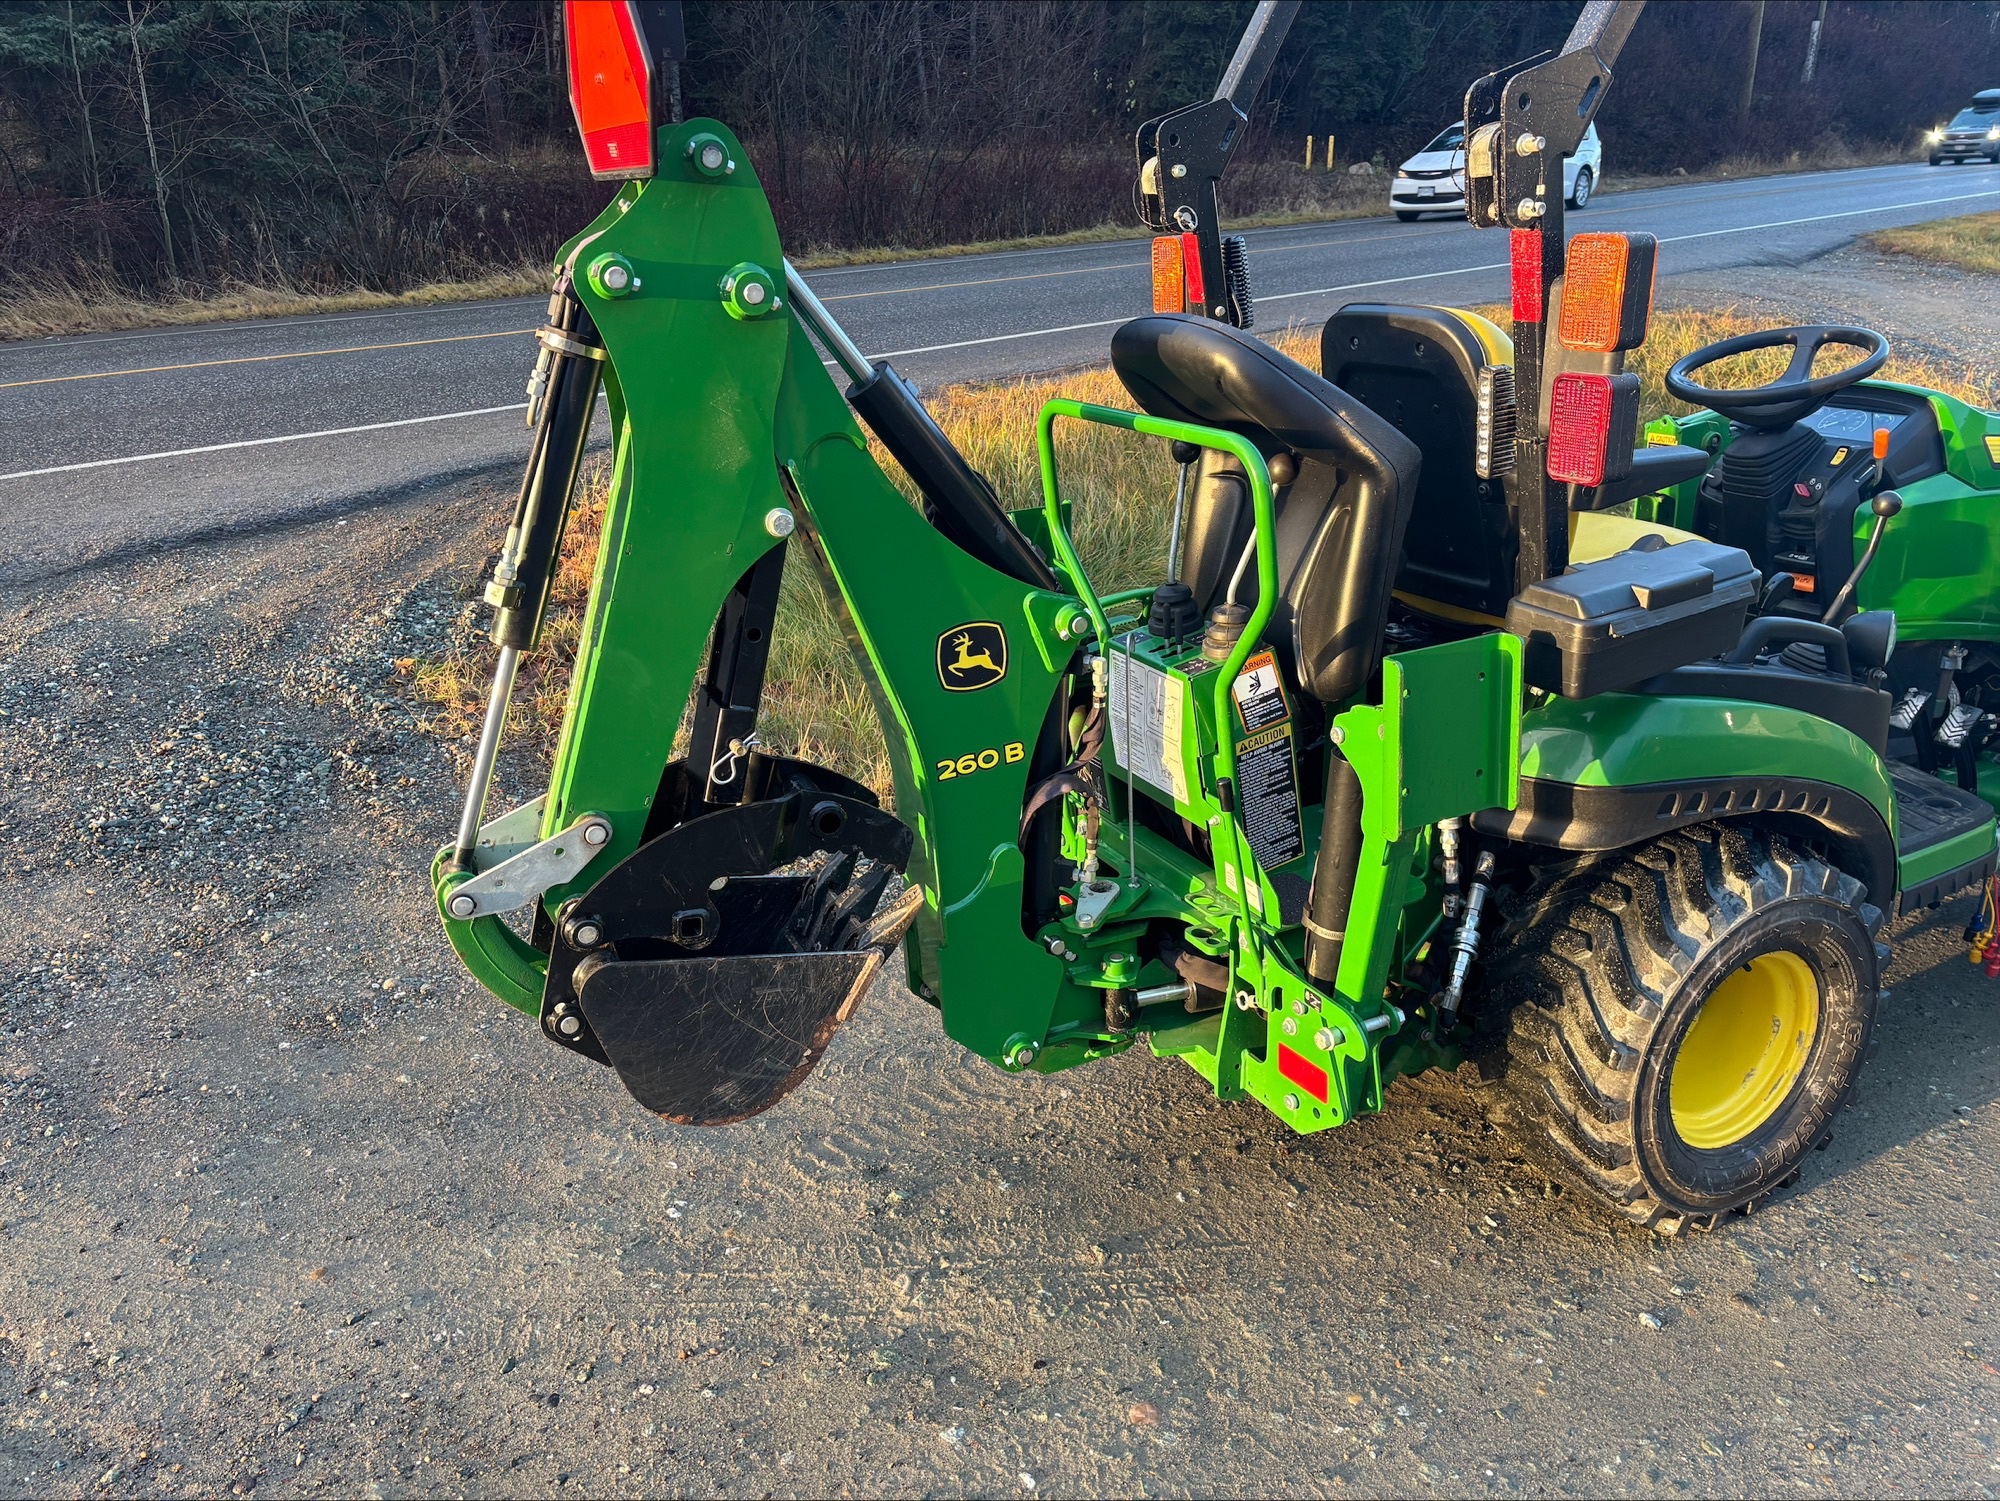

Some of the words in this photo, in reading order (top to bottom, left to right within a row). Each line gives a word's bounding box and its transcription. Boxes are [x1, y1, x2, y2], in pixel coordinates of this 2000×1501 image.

[1242, 655, 1271, 672] ARNING
[1247, 726, 1285, 749] CAUTION
[936, 749, 999, 781] 260
[1004, 742, 1025, 763] B
[1240, 752, 1253, 761] HELP
[1254, 746, 1268, 756] AVOID
[1268, 739, 1285, 750] INJURY
[1765, 1020, 1863, 1175] CARLISLE
